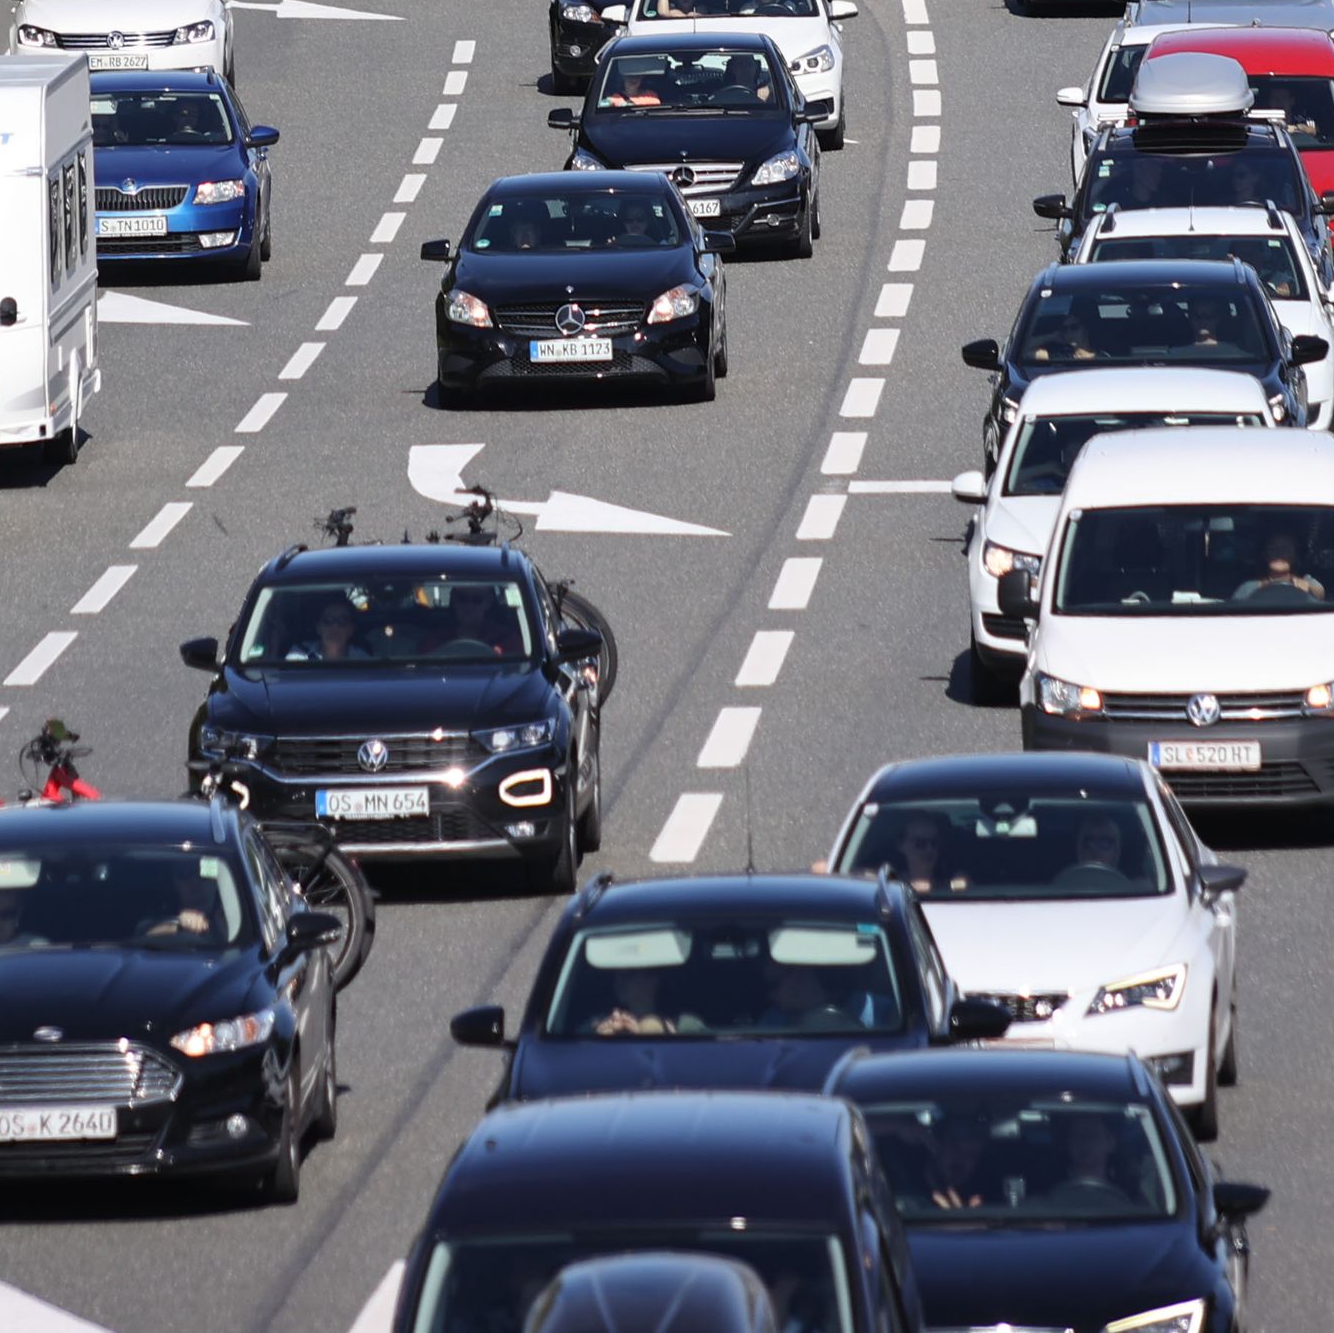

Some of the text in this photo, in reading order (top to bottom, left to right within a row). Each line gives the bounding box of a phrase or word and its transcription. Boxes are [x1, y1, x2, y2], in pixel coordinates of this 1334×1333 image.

[91, 56, 147, 68] EM RB 2627
[693, 203, 719, 215] 6167
[101, 219, 164, 232] S TN 1010
[540, 342, 610, 356] WN KB 1123
[1164, 746, 1252, 763] SL 520 HT
[329, 792, 426, 813] OS MN 654
[40, 1113, 53, 1136] K
[59, 1111, 113, 1135] 2640
